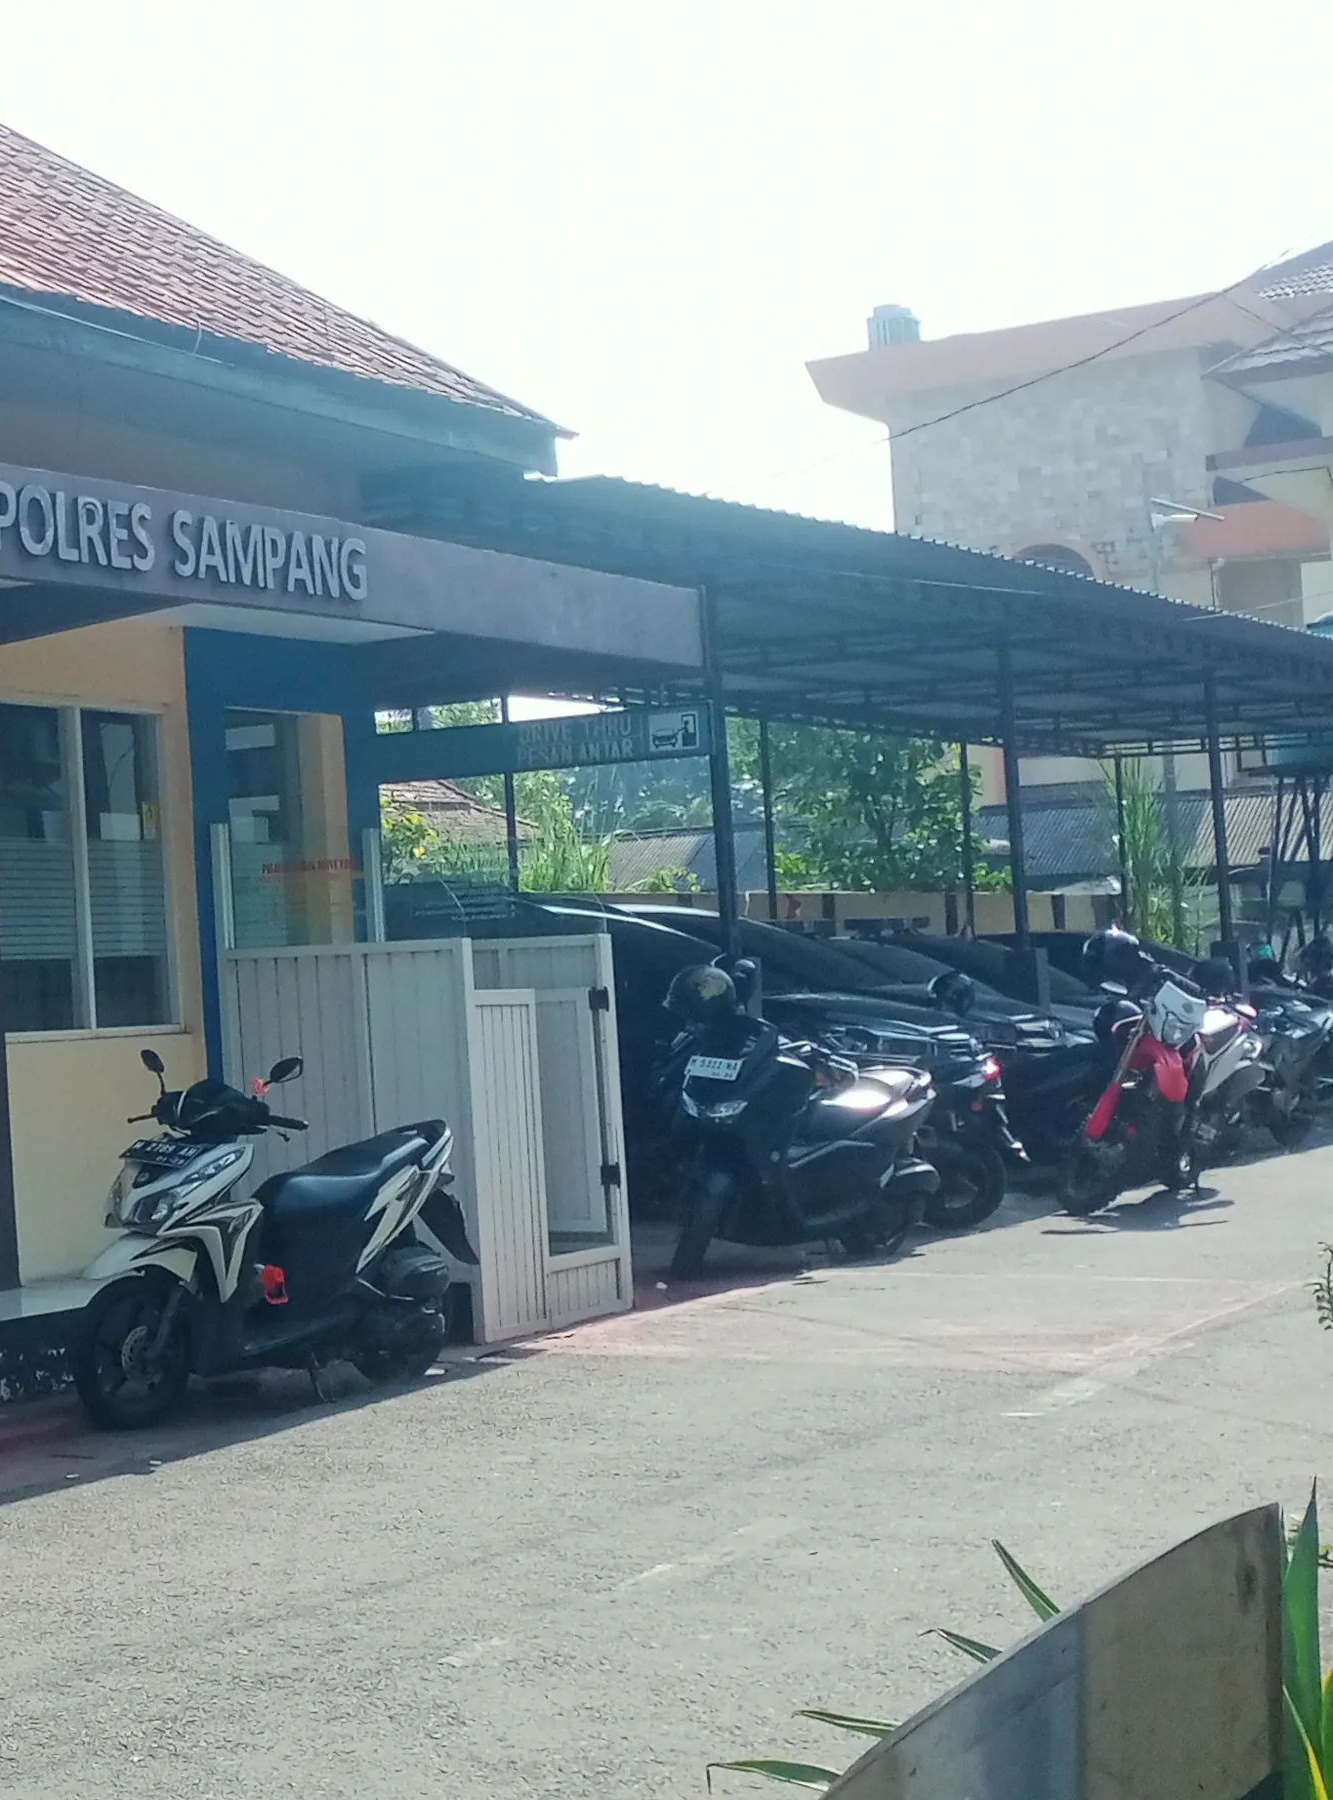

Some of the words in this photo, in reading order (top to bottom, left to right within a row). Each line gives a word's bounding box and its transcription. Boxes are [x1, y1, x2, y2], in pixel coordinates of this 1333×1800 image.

[172, 509, 368, 601] SAMPANG
[518, 722, 572, 744] DRIVE
[584, 715, 632, 737] THRU
[517, 743, 573, 767] PESAN
[579, 739, 633, 761] ANTAR
